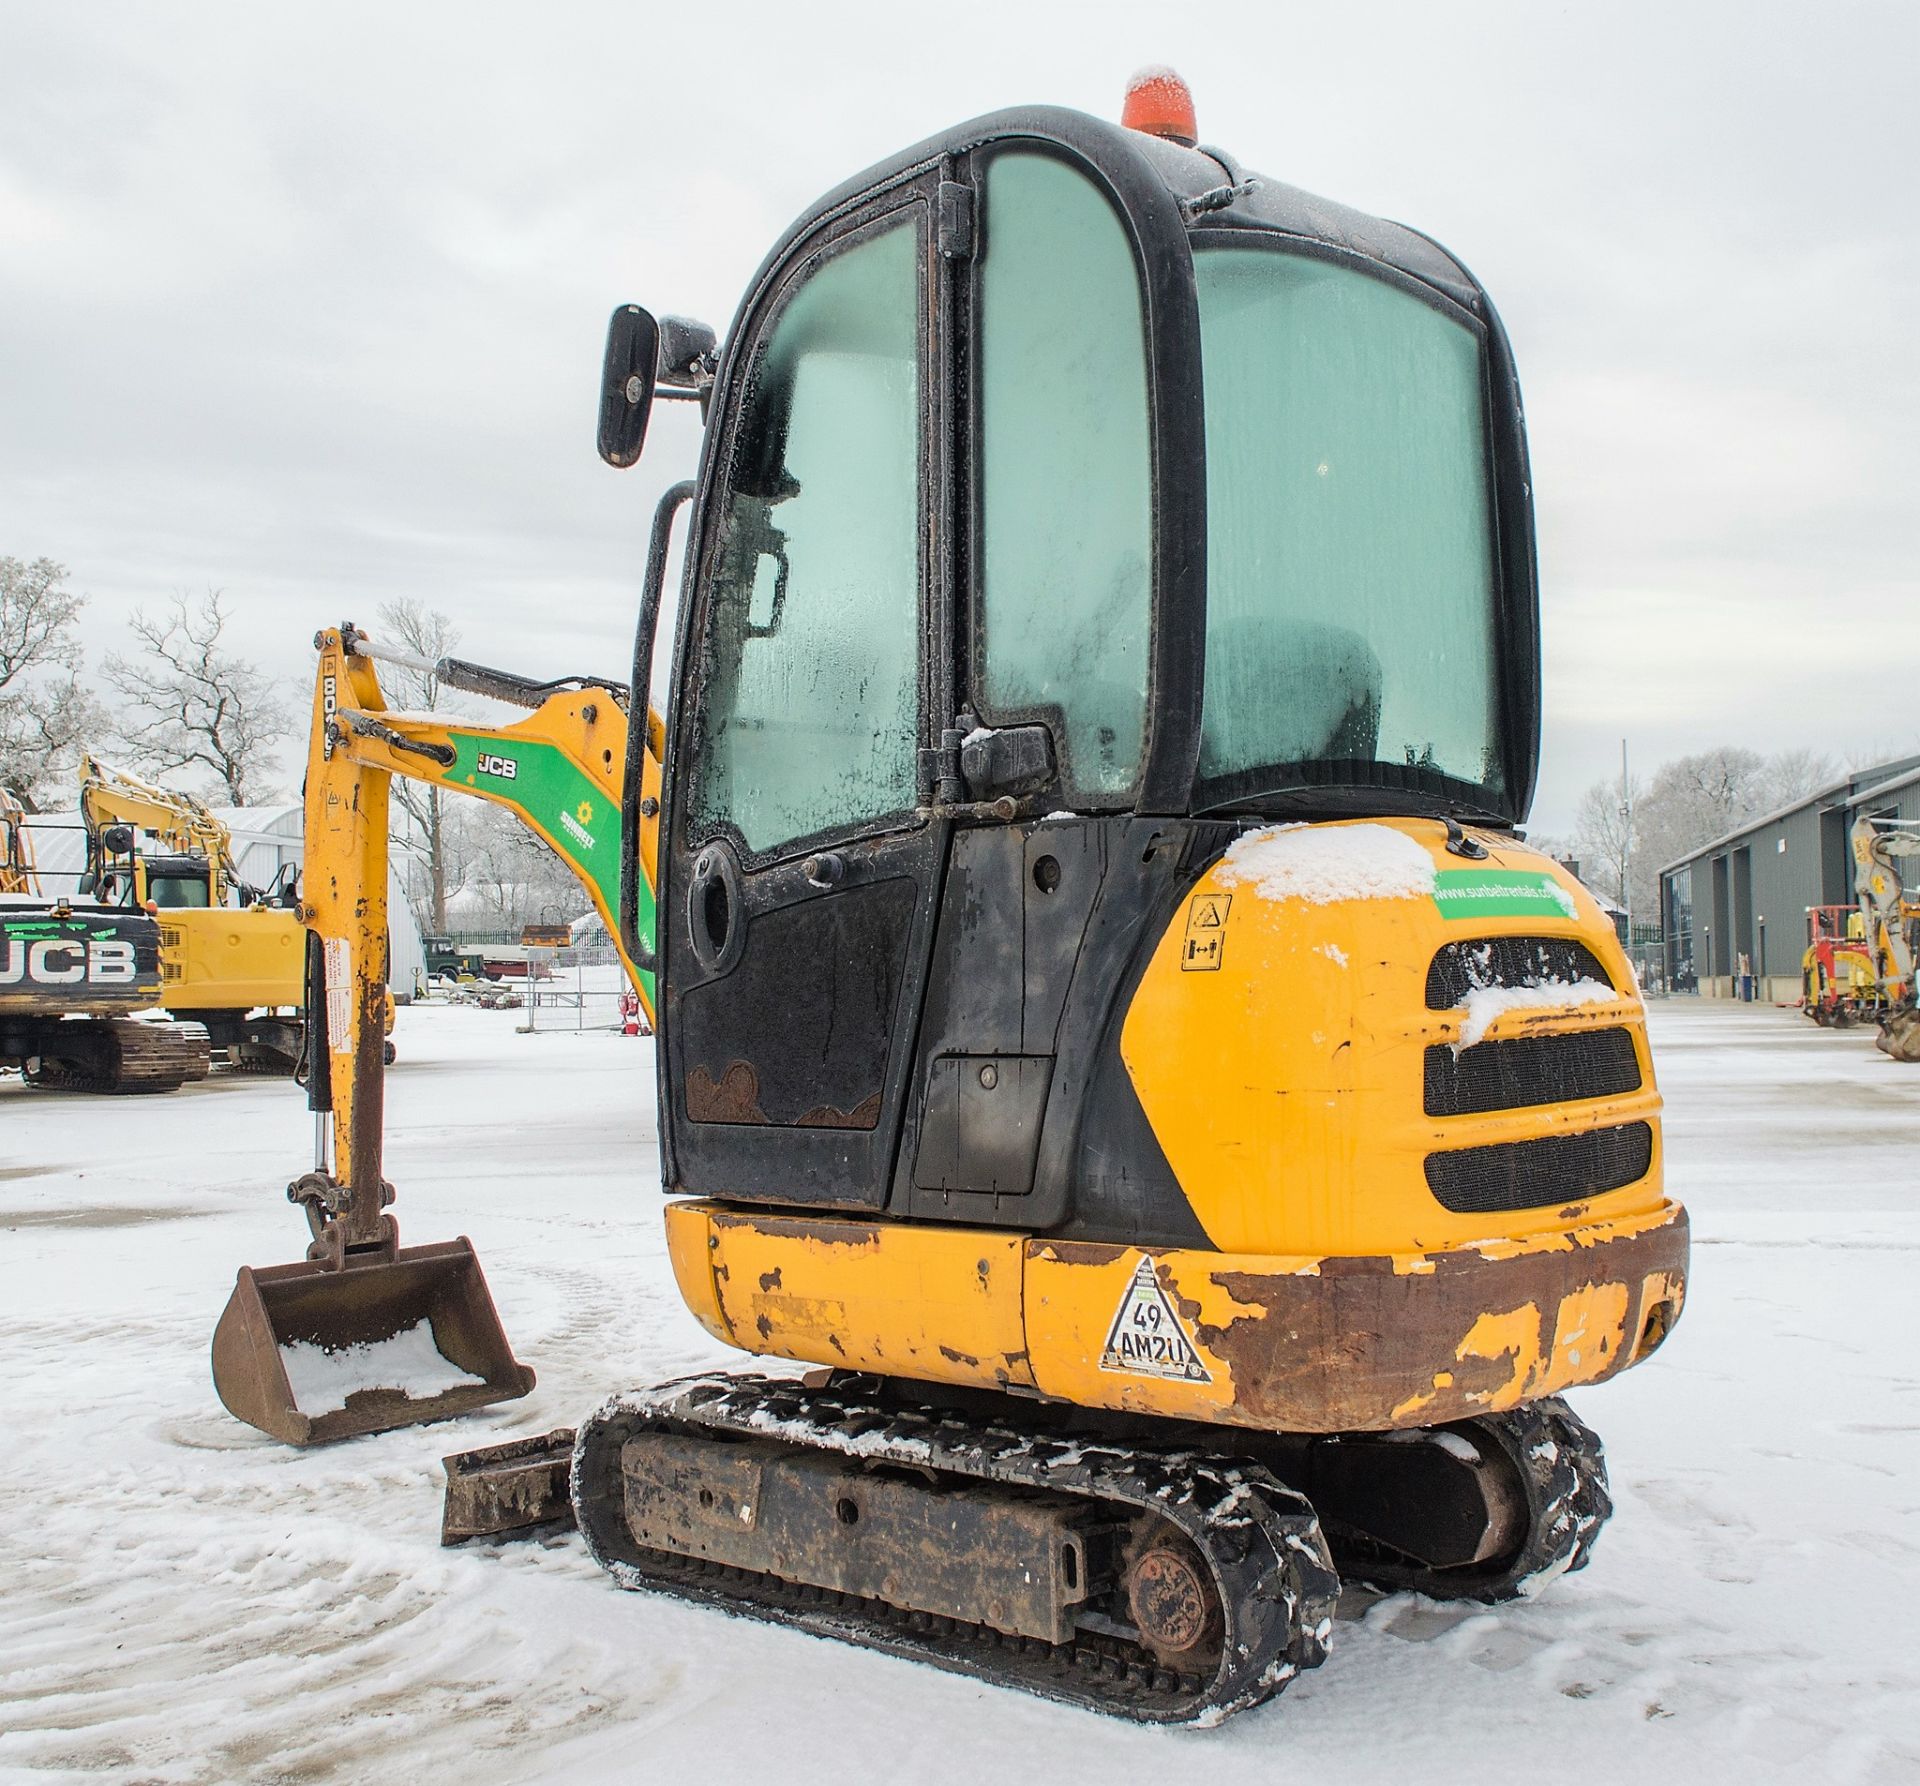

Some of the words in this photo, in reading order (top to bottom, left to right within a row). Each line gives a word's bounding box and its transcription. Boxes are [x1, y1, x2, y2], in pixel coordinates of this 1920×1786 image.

[477, 754, 517, 779] JCB
[560, 810, 596, 849] SUNBELT
[1434, 884, 1552, 900] www.sunbeltrentals.co
[0, 940, 137, 984] JCB
[1134, 1303, 1161, 1332] 49
